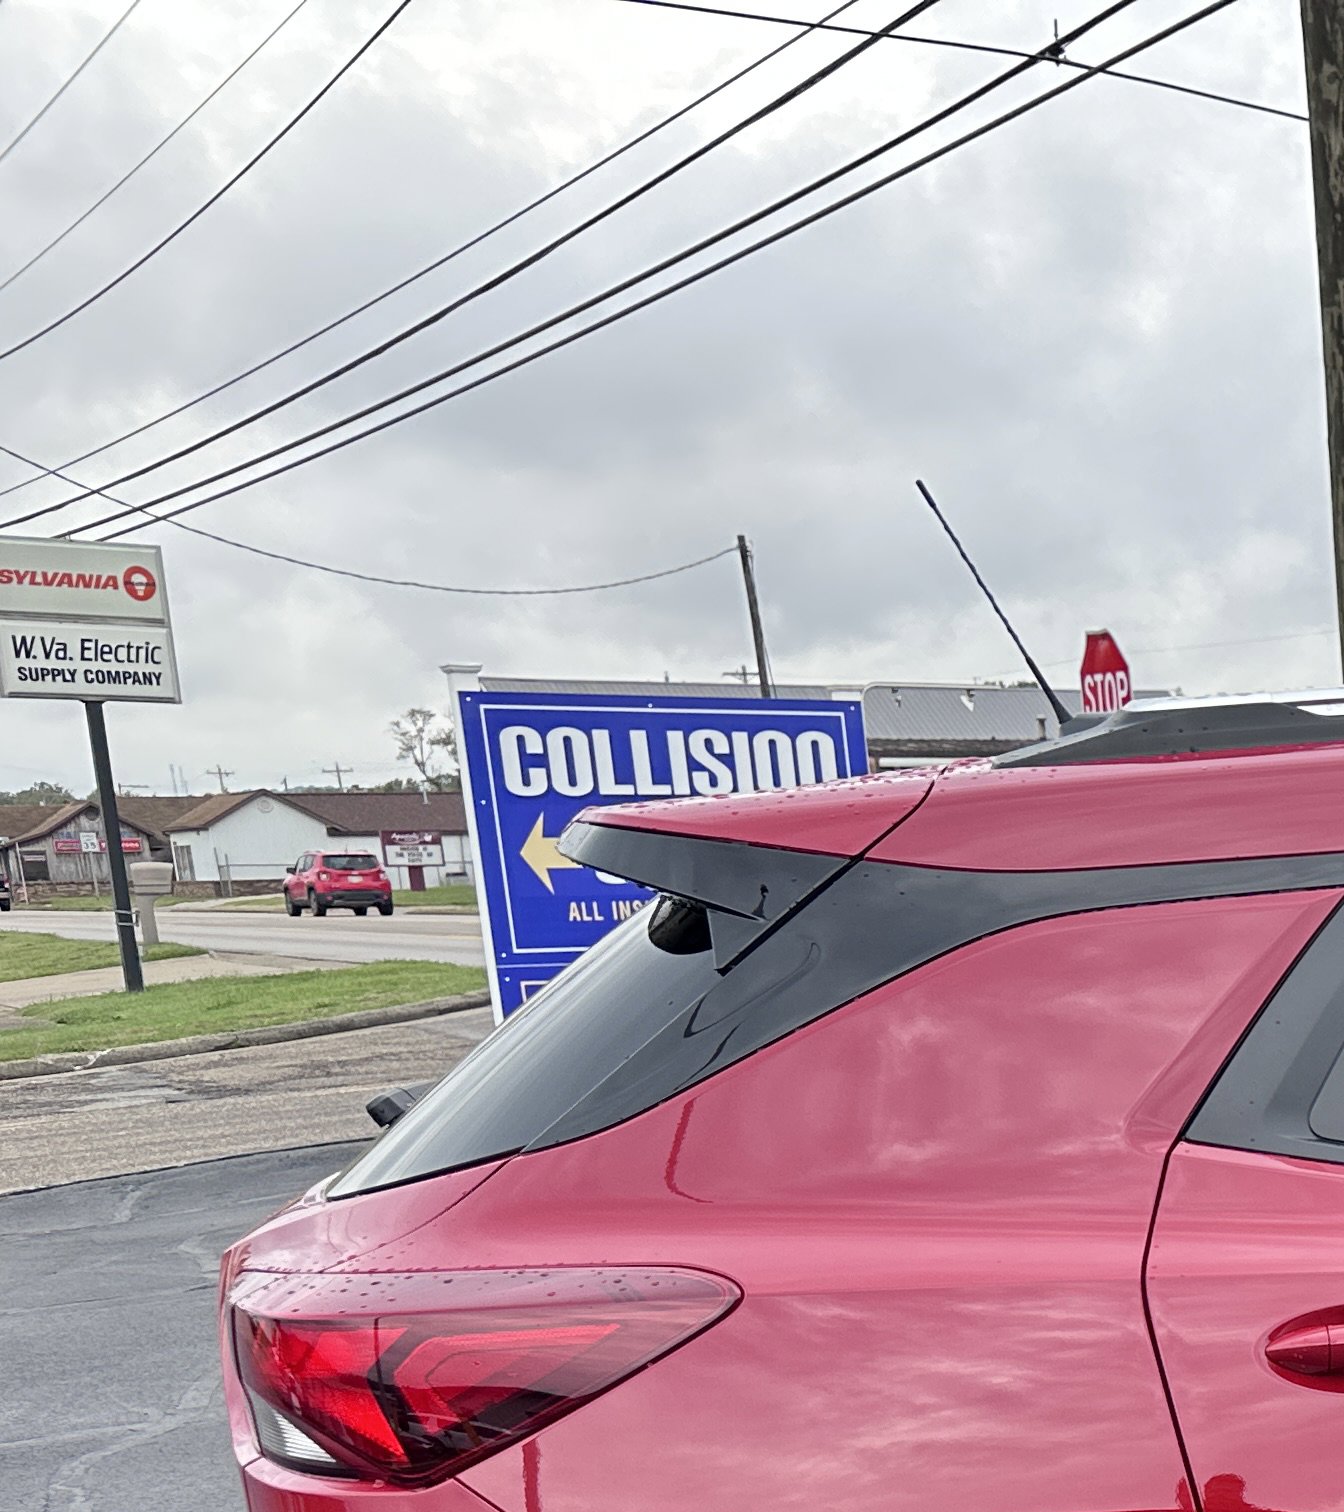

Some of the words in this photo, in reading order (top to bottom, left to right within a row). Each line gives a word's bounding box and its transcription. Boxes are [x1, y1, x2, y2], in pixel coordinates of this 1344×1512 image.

[0, 569, 119, 590] SYLVANIA
[12, 635, 73, 661] W.Va.
[80, 638, 162, 664] Electric
[17, 666, 77, 683] SUPPLY
[84, 669, 162, 686] COMPANY
[1084, 671, 1128, 713] STOP
[500, 725, 838, 797] COLLISION
[569, 901, 604, 921] ALL
